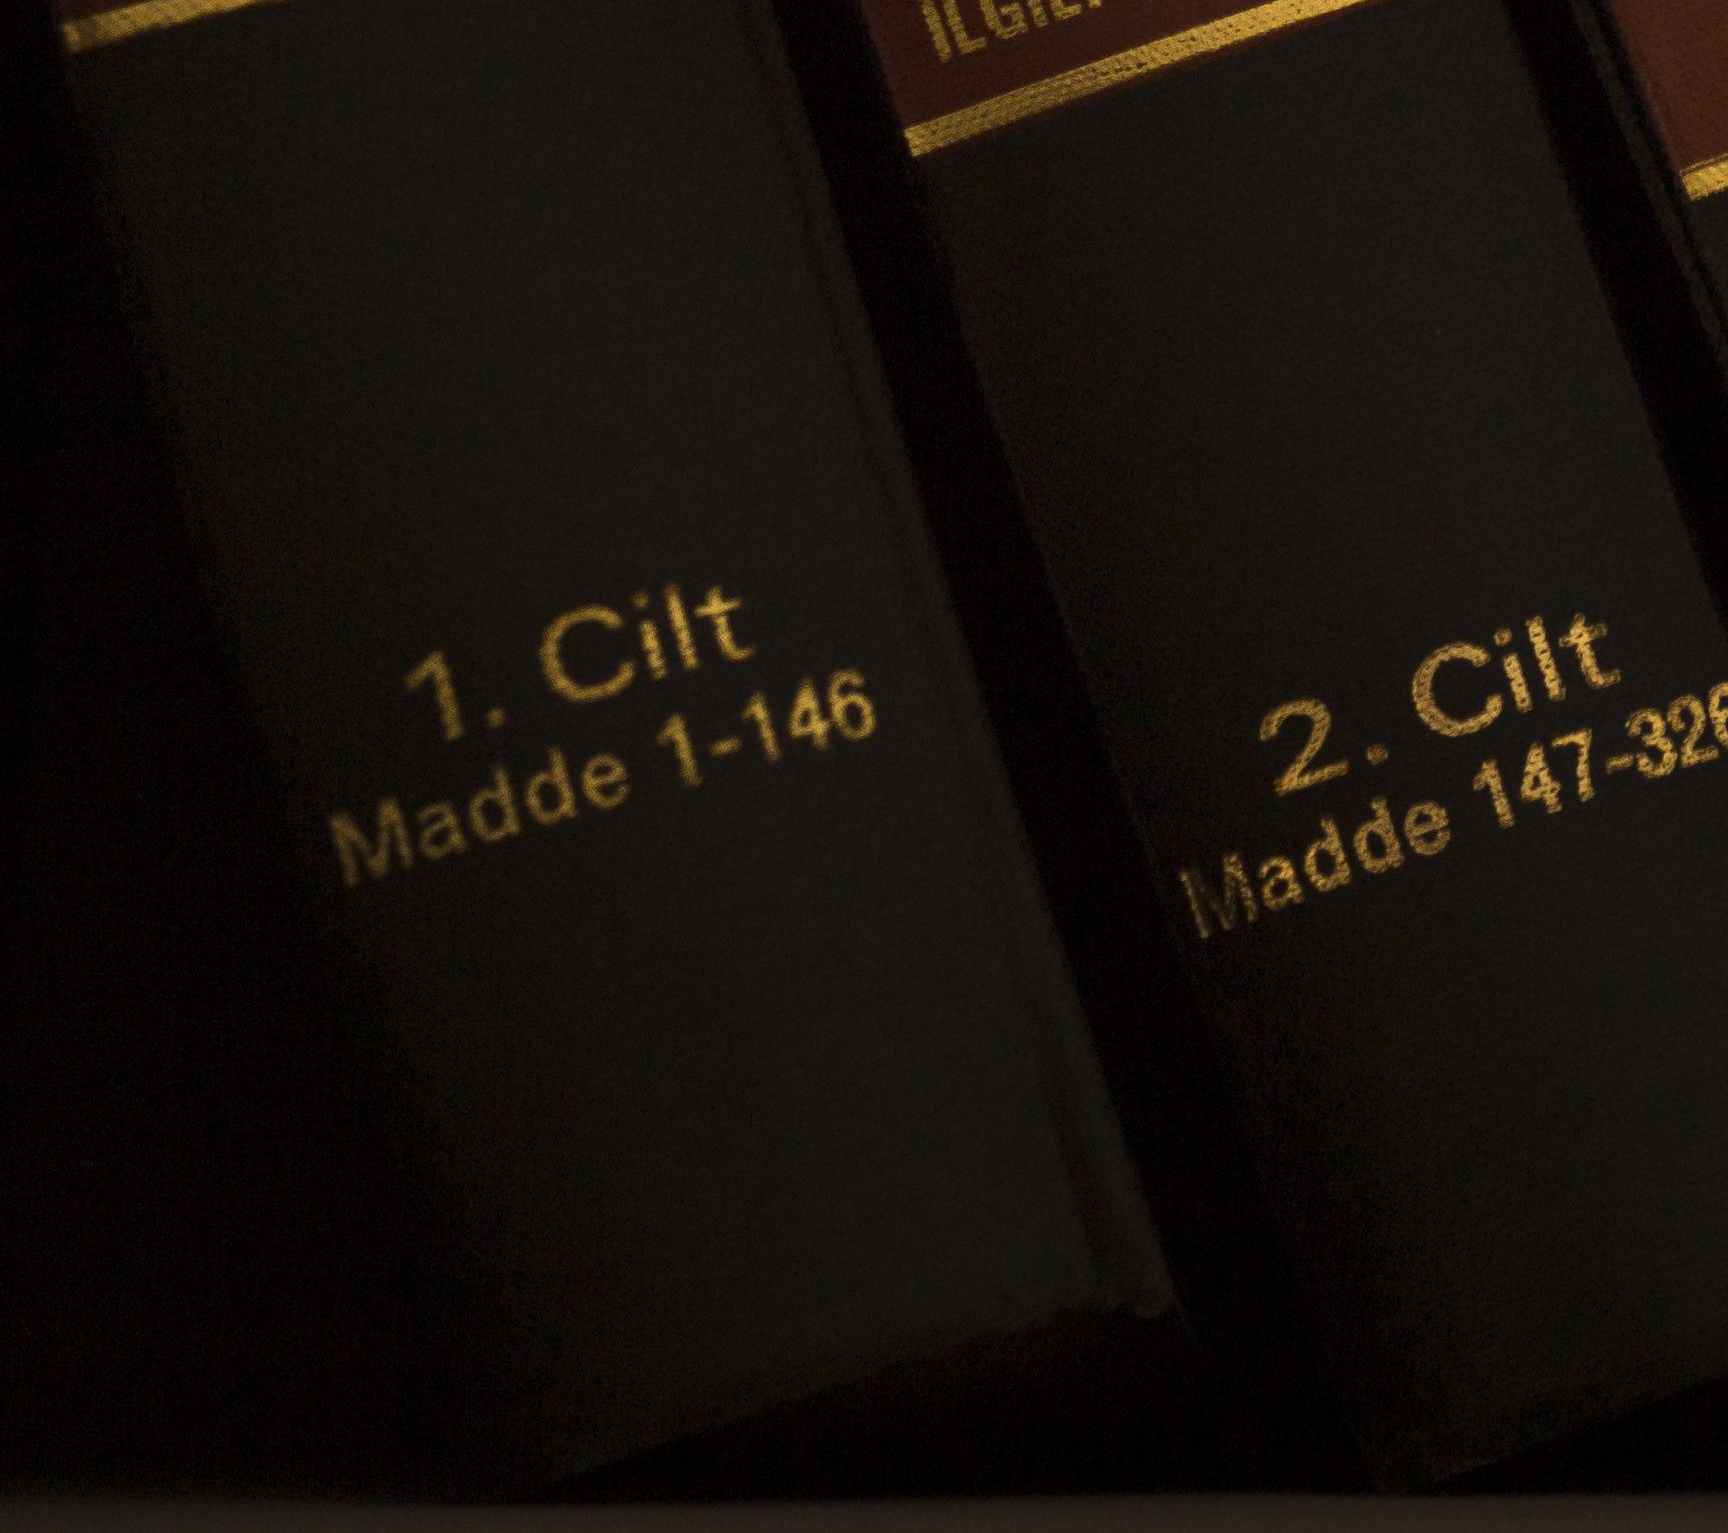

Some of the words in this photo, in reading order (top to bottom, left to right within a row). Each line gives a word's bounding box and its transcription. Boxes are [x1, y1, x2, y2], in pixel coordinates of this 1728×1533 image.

[405, 650, 505, 740] 1.
[539, 582, 756, 703] Cilt
[1258, 698, 1389, 798] 2.
[1410, 613, 1622, 737] Cilt
[327, 746, 631, 889] Madde
[657, 666, 877, 787] 1-146
[1177, 795, 1452, 940] Madde
